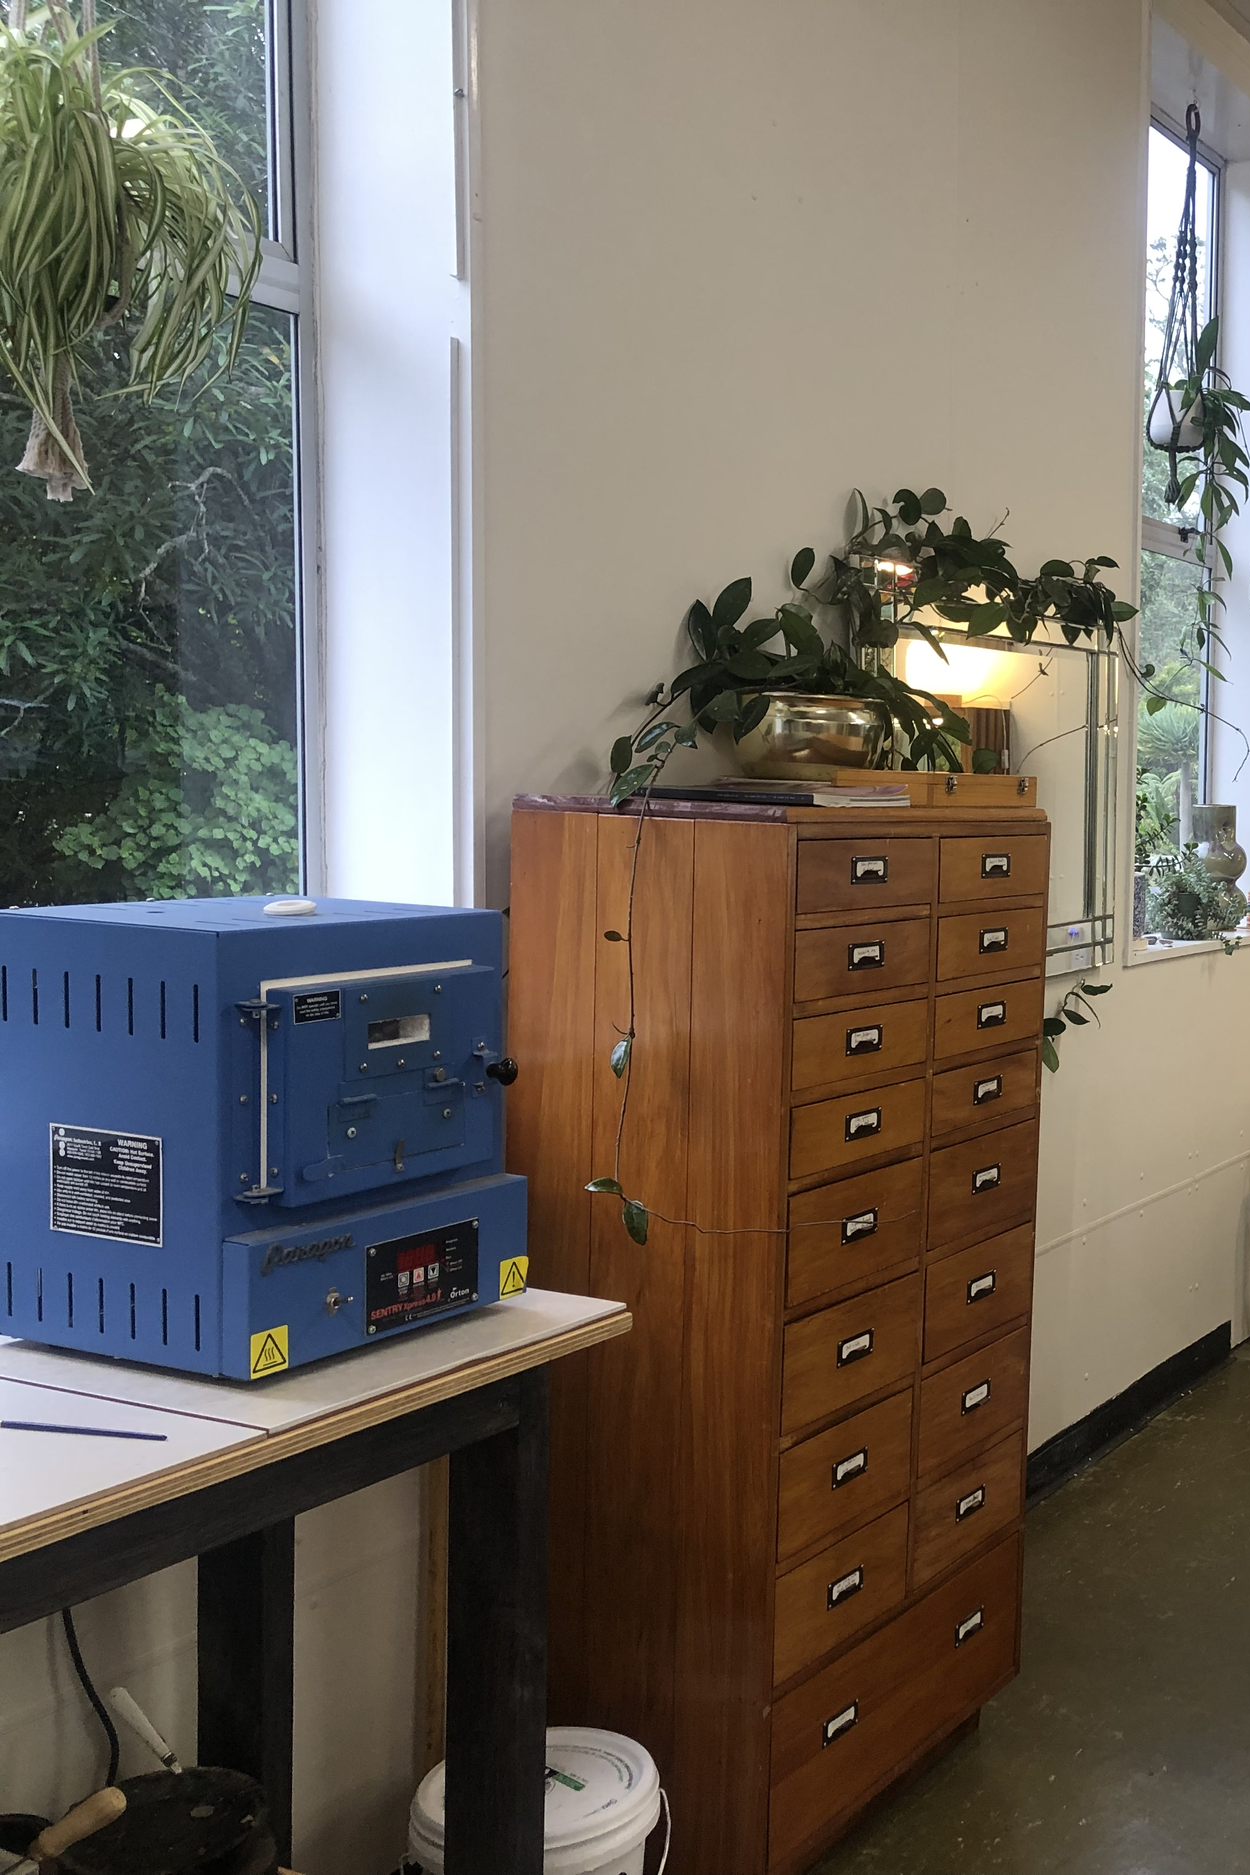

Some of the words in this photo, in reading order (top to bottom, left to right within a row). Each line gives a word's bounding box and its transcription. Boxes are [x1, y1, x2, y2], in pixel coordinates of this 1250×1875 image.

[117, 1139, 148, 1150] WARNING
[261, 1233, 356, 1277] Paragon
[450, 1288, 470, 1299] Orton
[371, 1303, 404, 1320] SENTRY
